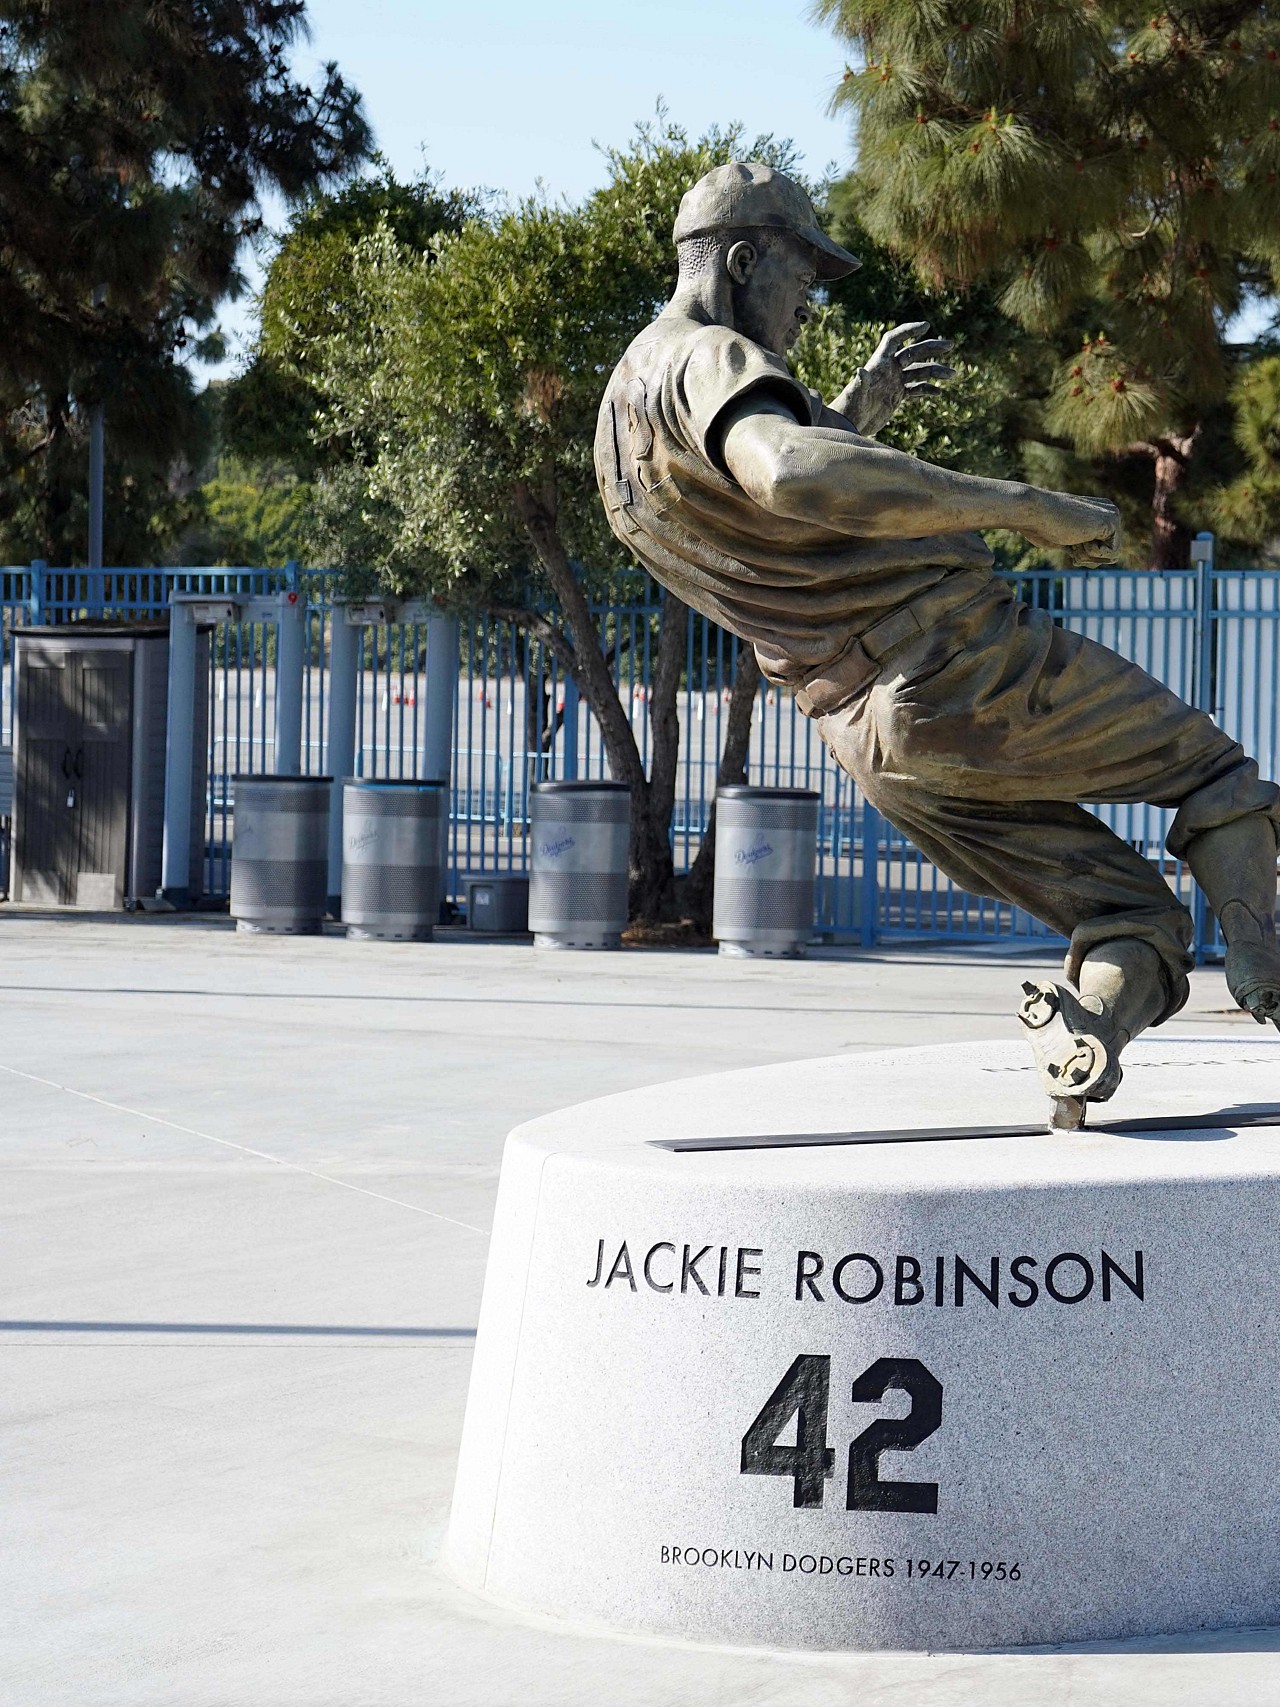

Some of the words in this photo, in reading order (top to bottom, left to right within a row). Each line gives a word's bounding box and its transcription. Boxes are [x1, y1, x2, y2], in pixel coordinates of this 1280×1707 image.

[586, 1239, 764, 1300] JACKIE
[794, 1249, 1145, 1309] ROBINSON
[740, 1353, 944, 1515] 42
[660, 1544, 774, 1571] BROOKLYN
[782, 1553, 895, 1578] DODGERS
[906, 1558, 1022, 1581] 1947-1956
